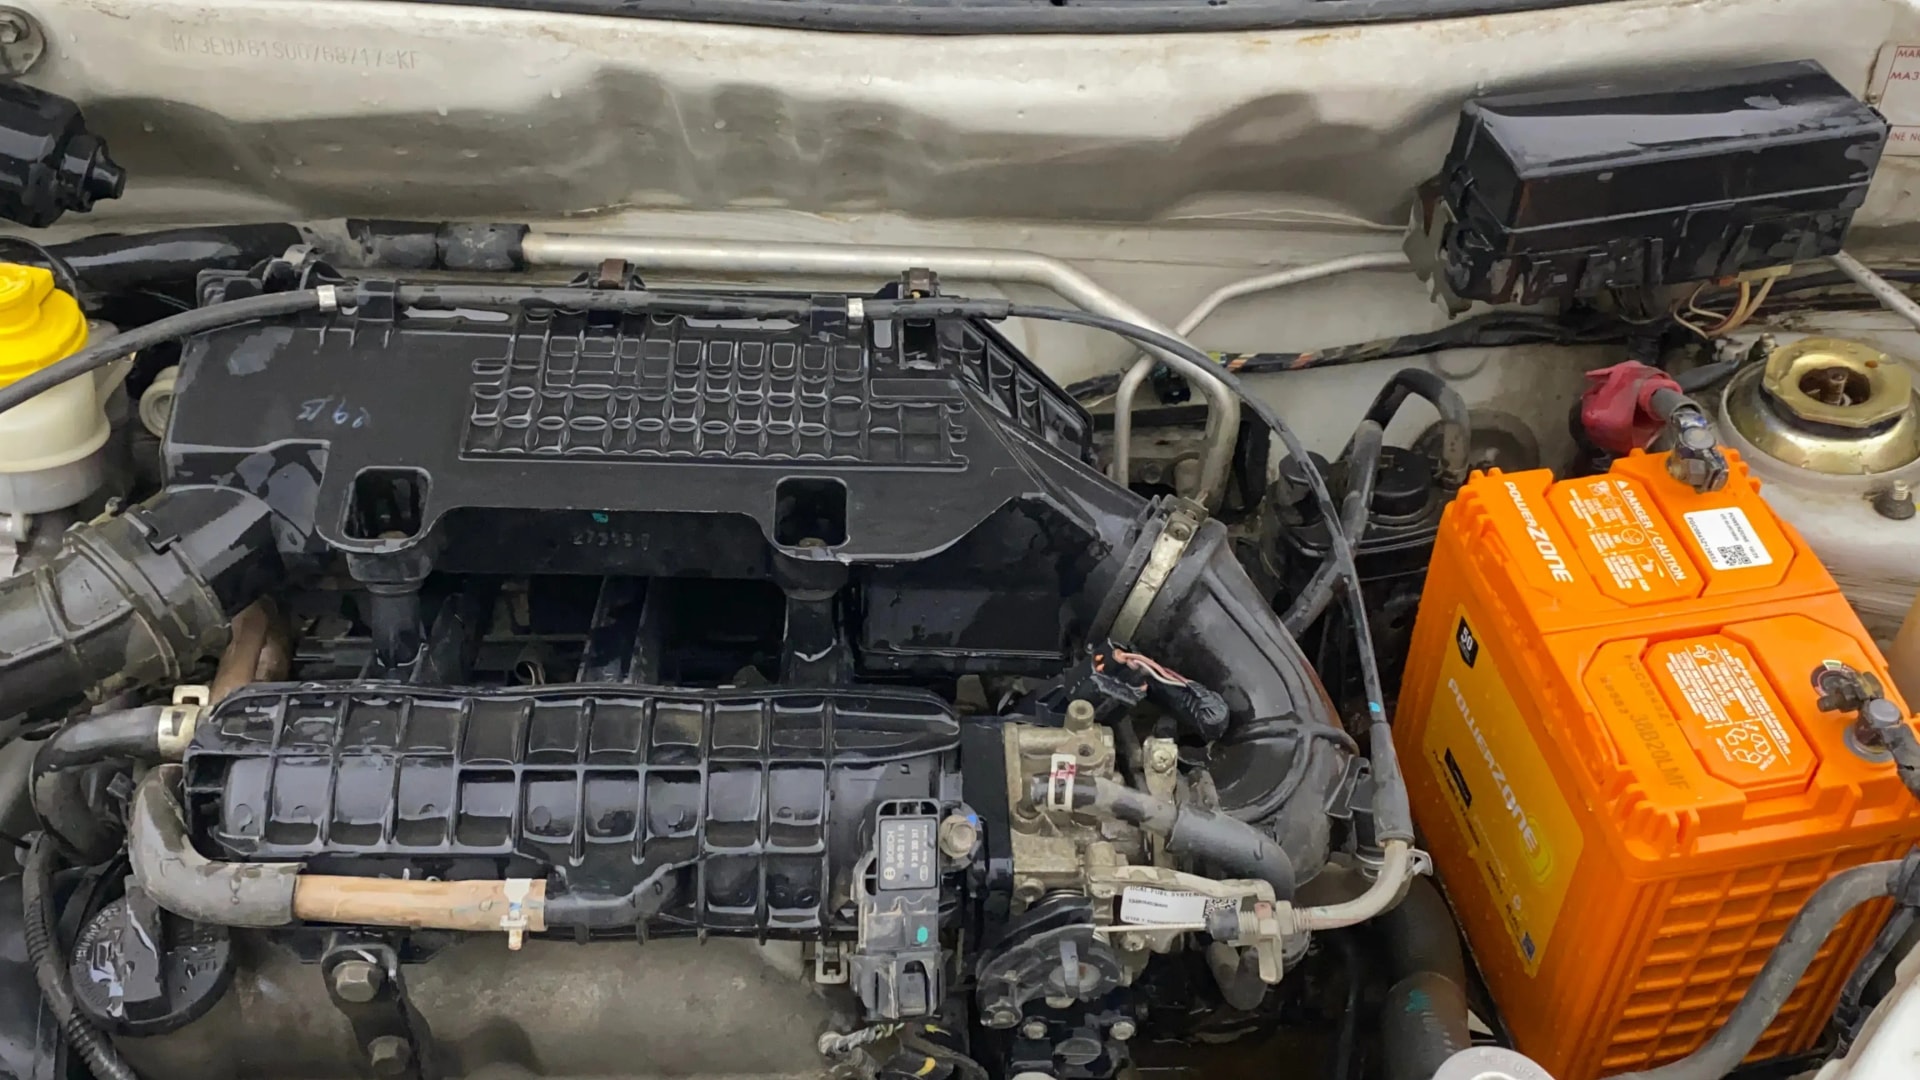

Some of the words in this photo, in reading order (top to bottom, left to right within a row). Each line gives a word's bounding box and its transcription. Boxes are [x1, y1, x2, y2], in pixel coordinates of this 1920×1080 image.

[1504, 481, 1574, 583] POWERZONE
[1622, 489, 1654, 529] DANGER
[1652, 536, 1687, 580] CAUTION
[1460, 626, 1474, 651] 50
[1447, 678, 1538, 853] POWERZONE
[886, 830, 895, 864] BOSCH
